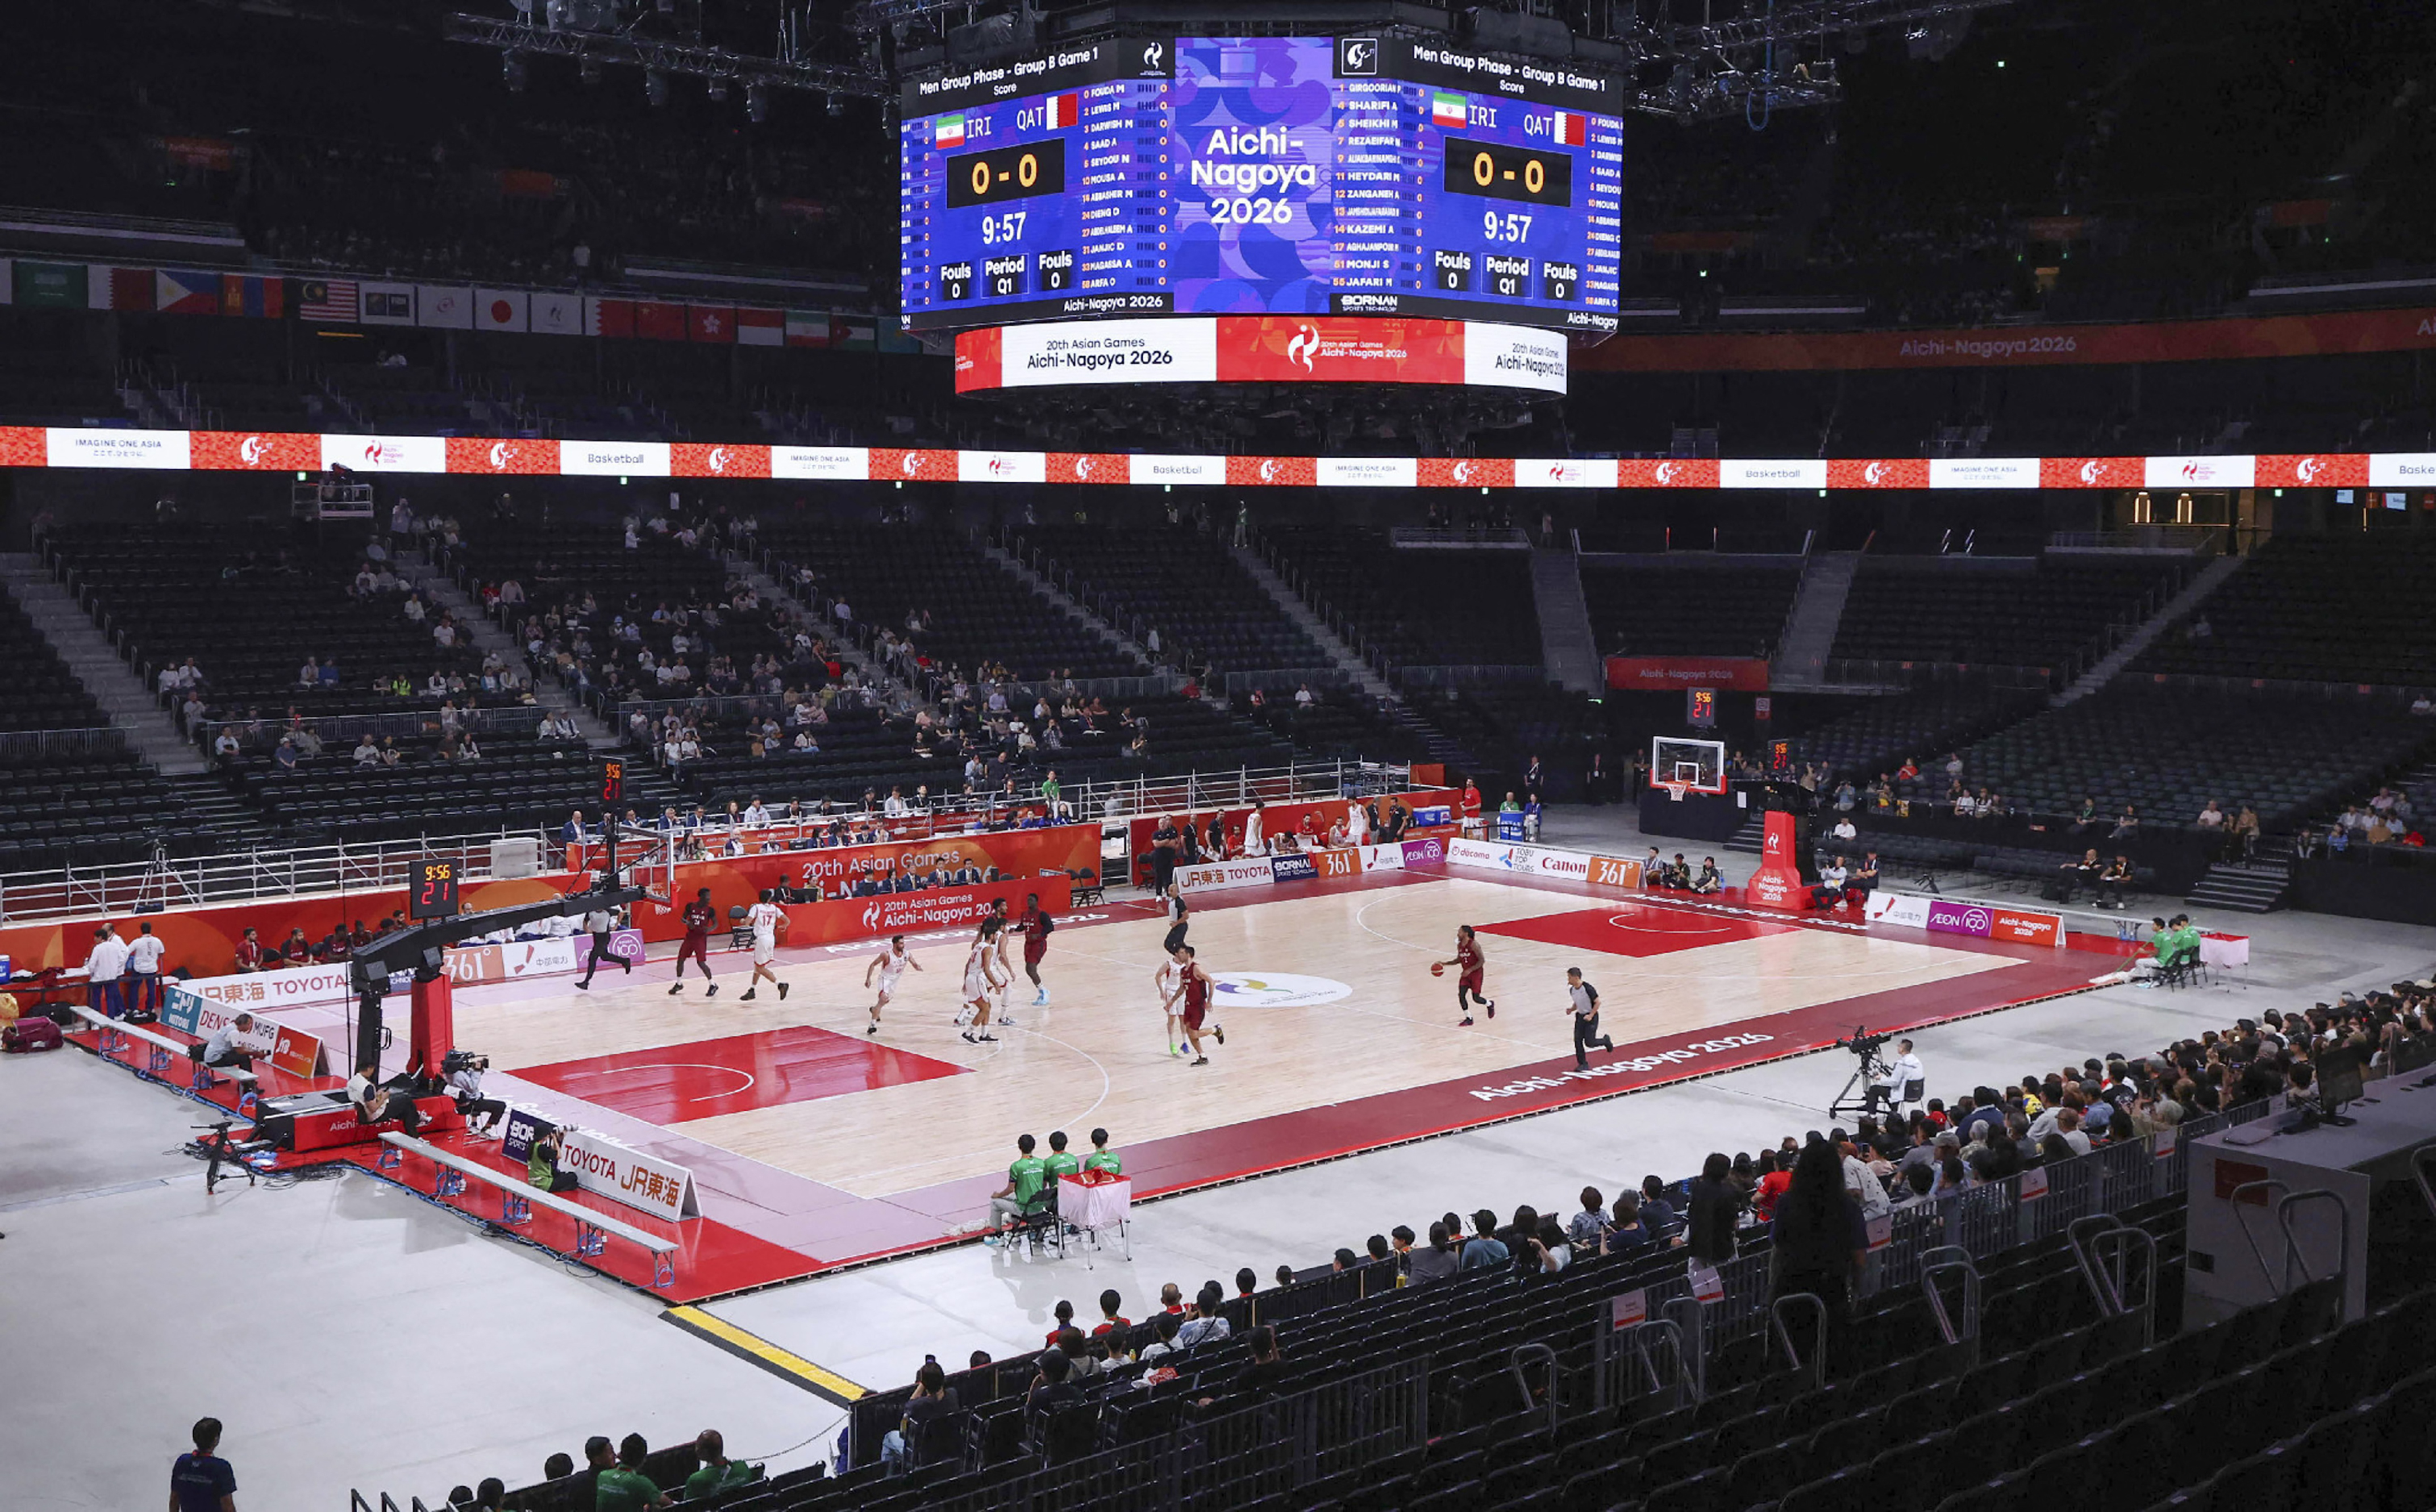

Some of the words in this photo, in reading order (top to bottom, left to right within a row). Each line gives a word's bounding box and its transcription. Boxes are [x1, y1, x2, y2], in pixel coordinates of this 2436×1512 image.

[919, 80, 939, 95] Men
[942, 73, 972, 91] Group
[974, 68, 1004, 85] Phase
[1014, 61, 1046, 77] Group
[1049, 56, 1055, 69] B
[1058, 49, 1090, 67] Game
[1093, 47, 1098, 60] 1
[1414, 45, 1437, 63] Men
[1440, 50, 1476, 71] Group
[1478, 56, 1511, 74] Phase
[1523, 65, 1554, 85] Group
[1558, 71, 1565, 84] B
[1567, 74, 1597, 91] Game
[1600, 79, 1605, 92] 1
[994, 83, 1017, 96] Score
[1092, 86, 1115, 97] FOUDA
[1500, 80, 1524, 94] Score
[1092, 103, 1111, 115] LEWIS
[1349, 101, 1390, 110] SHARIFI
[1392, 102, 1397, 110] A
[1017, 107, 1044, 130] QAT
[1348, 119, 1389, 128] SHEIKHI
[1469, 105, 1497, 128] IRI
[966, 116, 992, 138] IRI
[1091, 119, 1122, 132] DARWISH
[1524, 114, 1552, 137] QAT
[1092, 139, 1110, 149] SAAD
[1206, 126, 1304, 155] Aichi-
[972, 161, 990, 194] 0
[1018, 153, 1038, 188] 0
[1090, 173, 1115, 184] MOUSA
[1118, 172, 1125, 181] A
[1191, 160, 1316, 193] Nagoya
[1473, 152, 1494, 187] 0
[1524, 160, 1544, 194] 0
[1210, 197, 1293, 224] 2026
[982, 211, 1026, 244] 9:57
[1347, 225, 1386, 234] KAZEMI
[1483, 210, 1532, 243] 9:57
[985, 256, 1025, 275] Period
[1039, 252, 1072, 269] Fouls
[1383, 260, 1389, 269] S
[1435, 251, 1471, 270] Fouls
[1486, 257, 1530, 276] Period
[940, 263, 971, 280] Fouls
[1544, 262, 1577, 281] Fouls
[997, 278, 1012, 294] Q1
[1051, 272, 1060, 288] 0
[1090, 278, 1109, 288] ARFA
[1347, 278, 1383, 286] JAFARI
[1448, 273, 1458, 288] 0
[1499, 278, 1515, 294] Q1
[952, 284, 960, 298] 0
[1555, 282, 1564, 298] 0
[1064, 294, 1126, 312] Aichi-Nagoya
[1129, 295, 1163, 308] 2026
[1340, 295, 1397, 306] BORNAN
[1046, 340, 1069, 351] 20th
[1071, 339, 1101, 349] Asian
[1104, 337, 1145, 348] Games
[1513, 343, 1528, 353] 20th
[1529, 344, 1544, 356] Asian
[1545, 346, 1559, 358] Games
[1901, 337, 2027, 357] Aichi-Nagoya
[2029, 335, 2077, 351] 2026
[1027, 351, 1125, 370] Aichi-Nagoya
[1130, 350, 1172, 365] 2026
[1321, 348, 1384, 359] Aichi-Nagoya
[1386, 349, 1408, 358] 2026
[1495, 355, 1554, 377] Aichi-Nagoya
[588, 453, 644, 464] Basketball
[1153, 465, 1202, 476] Basketball
[1746, 469, 1801, 478] Basketball
[1639, 669, 1706, 680] Aichi-Nagoya
[1708, 670, 1733, 680] 2026
[1695, 692, 1712, 703] 9:56
[1693, 703, 1711, 718] 21
[605, 763, 621, 779] 9:56
[603, 779, 619, 801] 21
[1517, 848, 1534, 857] TOBU
[425, 864, 451, 882] 9:56
[802, 859, 843, 879] 20th
[849, 855, 895, 874] Asian
[901, 851, 960, 867] Games
[1228, 865, 1271, 880] TOYOTA
[1513, 863, 1534, 872] TOURS
[1542, 857, 1586, 873] Canon
[1181, 869, 1225, 888] JR東海
[422, 881, 449, 905] 21
[1759, 882, 1787, 893] Nagoya
[884, 902, 907, 913] 20th
[910, 899, 936, 909] Asian
[939, 894, 972, 905] Games
[762, 915, 772, 926] 17
[884, 906, 972, 927] Aichi-Nagoya
[1999, 917, 2052, 931] Aichi-Nagoya
[2014, 927, 2034, 936] 2026
[273, 974, 347, 995] TOYOTA
[200, 1010, 235, 1030] DENS
[253, 1021, 274, 1039] MUFG
[1469, 1049, 1700, 1102] Aichi-Nagoya
[1689, 1033, 1775, 1053] 2026
[564, 1144, 615, 1180] TOYOTA
[621, 1164, 680, 1207] JR東海
